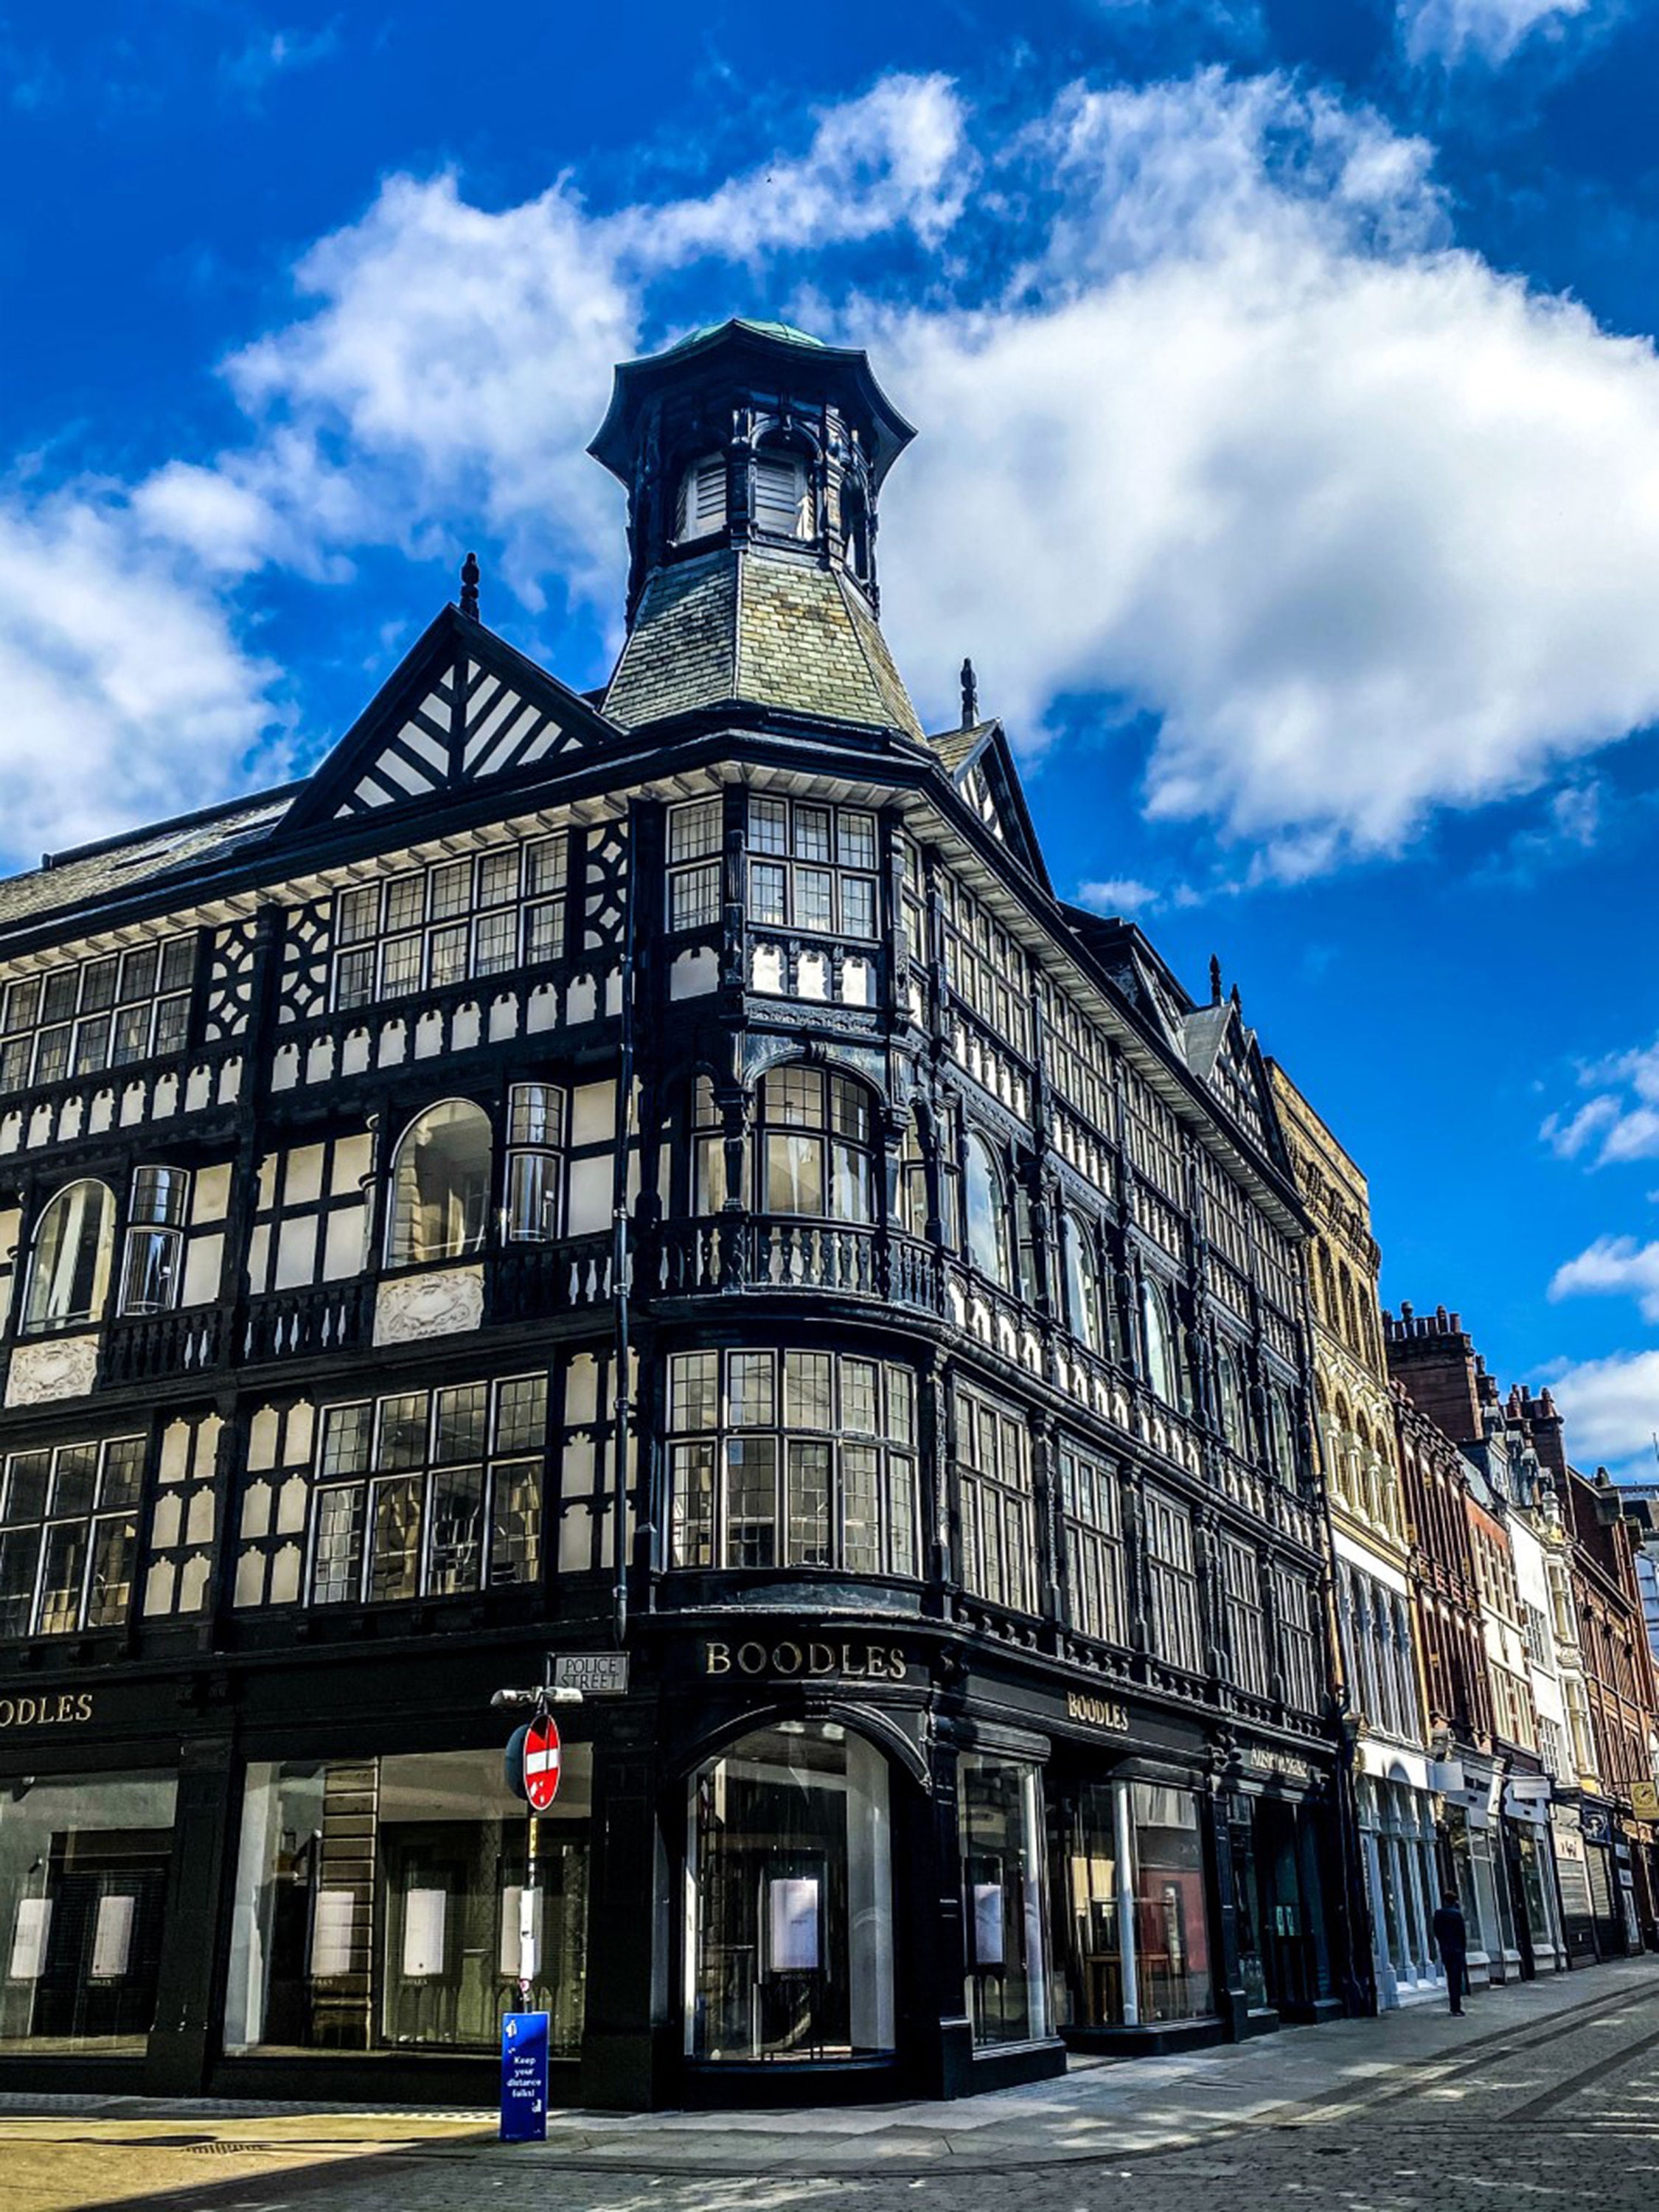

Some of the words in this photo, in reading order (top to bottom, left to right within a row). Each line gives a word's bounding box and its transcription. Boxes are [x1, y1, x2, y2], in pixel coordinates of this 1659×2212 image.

[565, 1658, 617, 1674] POLICE
[706, 1641, 907, 1679] BOODLES
[560, 1673, 619, 1689] STREET
[1067, 1691, 1129, 1731] BOODLES
[513, 2056, 536, 2066] Keep
[514, 2068, 535, 2078] your
[506, 2078, 541, 2087] distance
